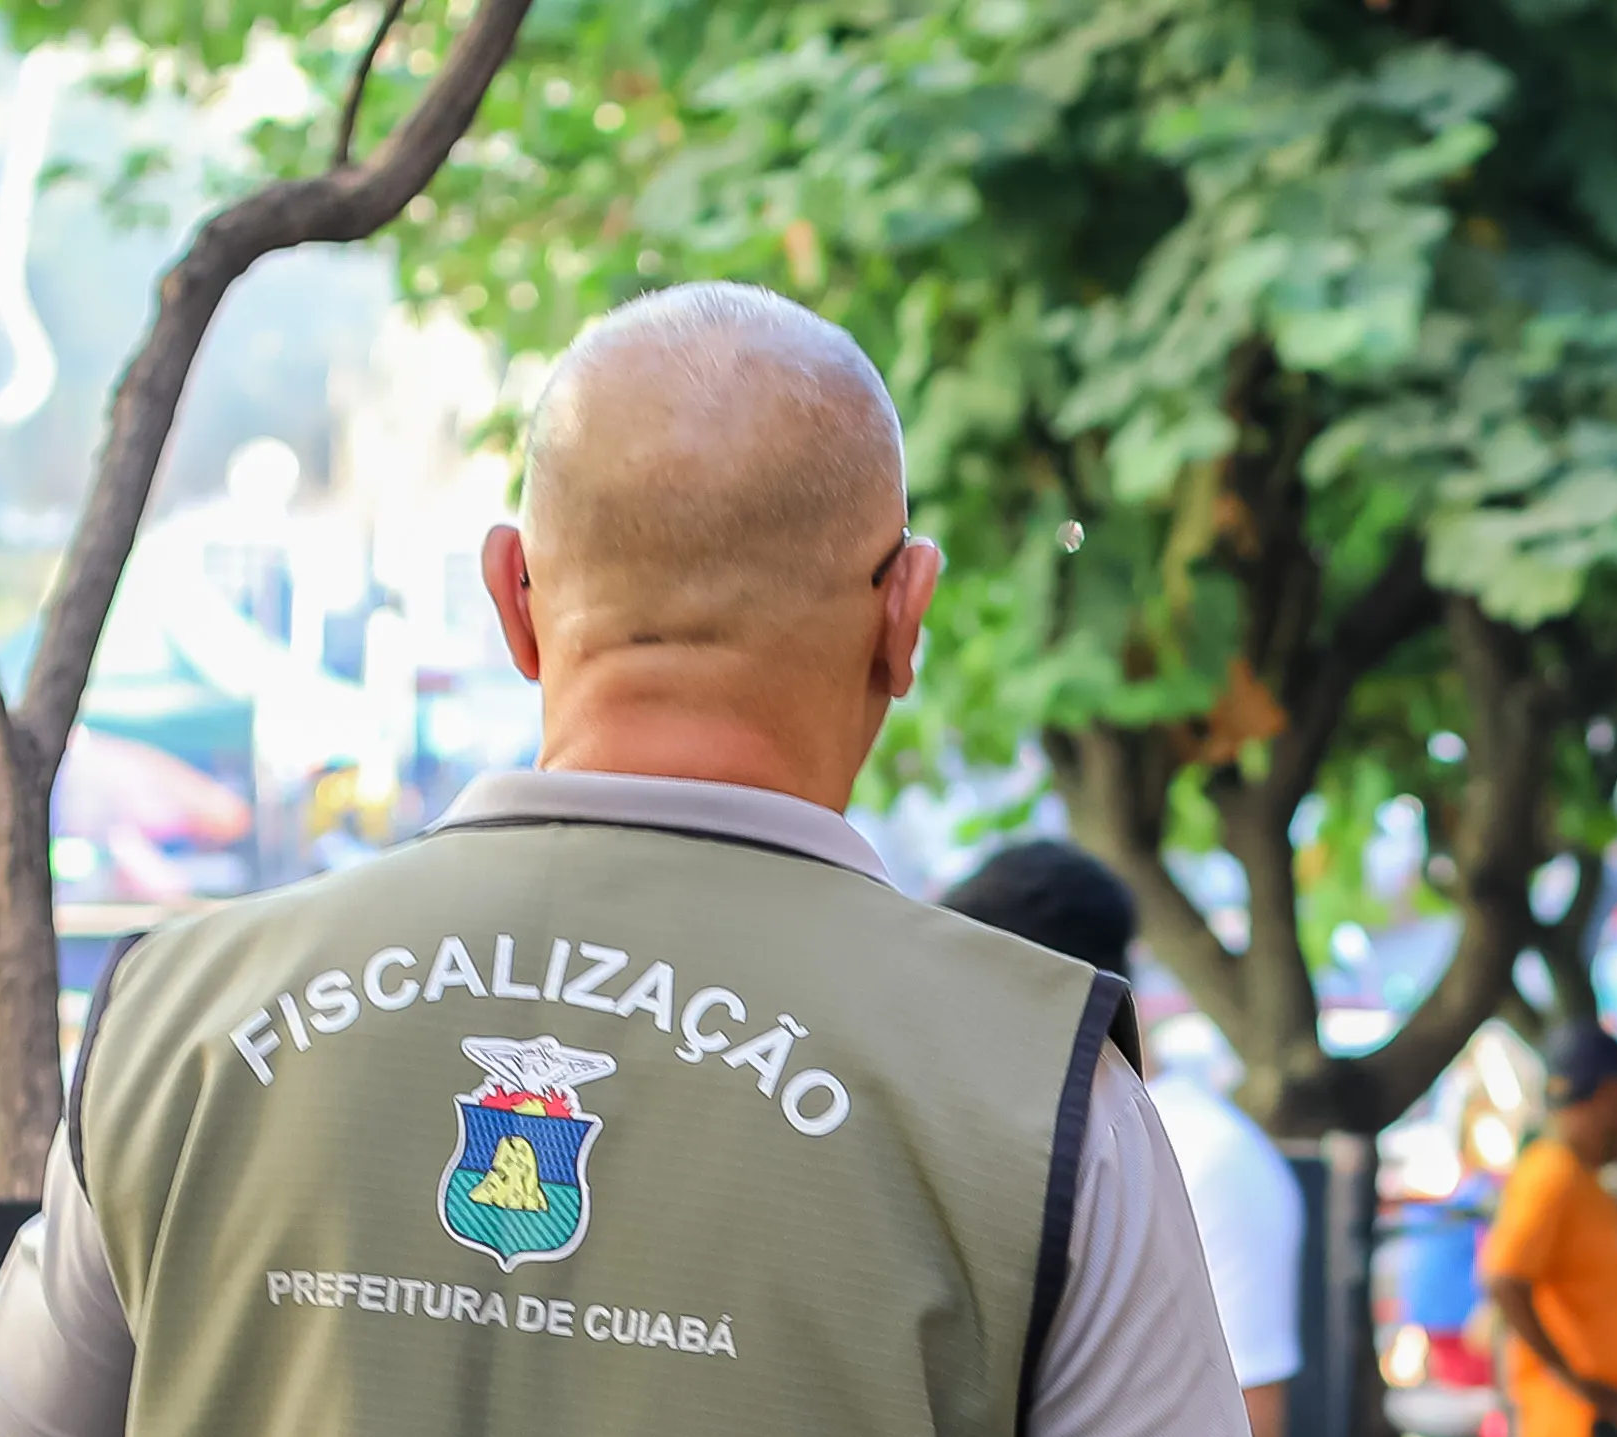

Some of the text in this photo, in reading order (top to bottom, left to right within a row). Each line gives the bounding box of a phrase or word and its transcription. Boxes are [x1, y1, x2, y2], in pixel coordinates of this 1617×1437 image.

[228, 933, 852, 1138] FISCALIZAÇÃO
[266, 1269, 739, 1360] PREFEITURA DE CUIABÁ
